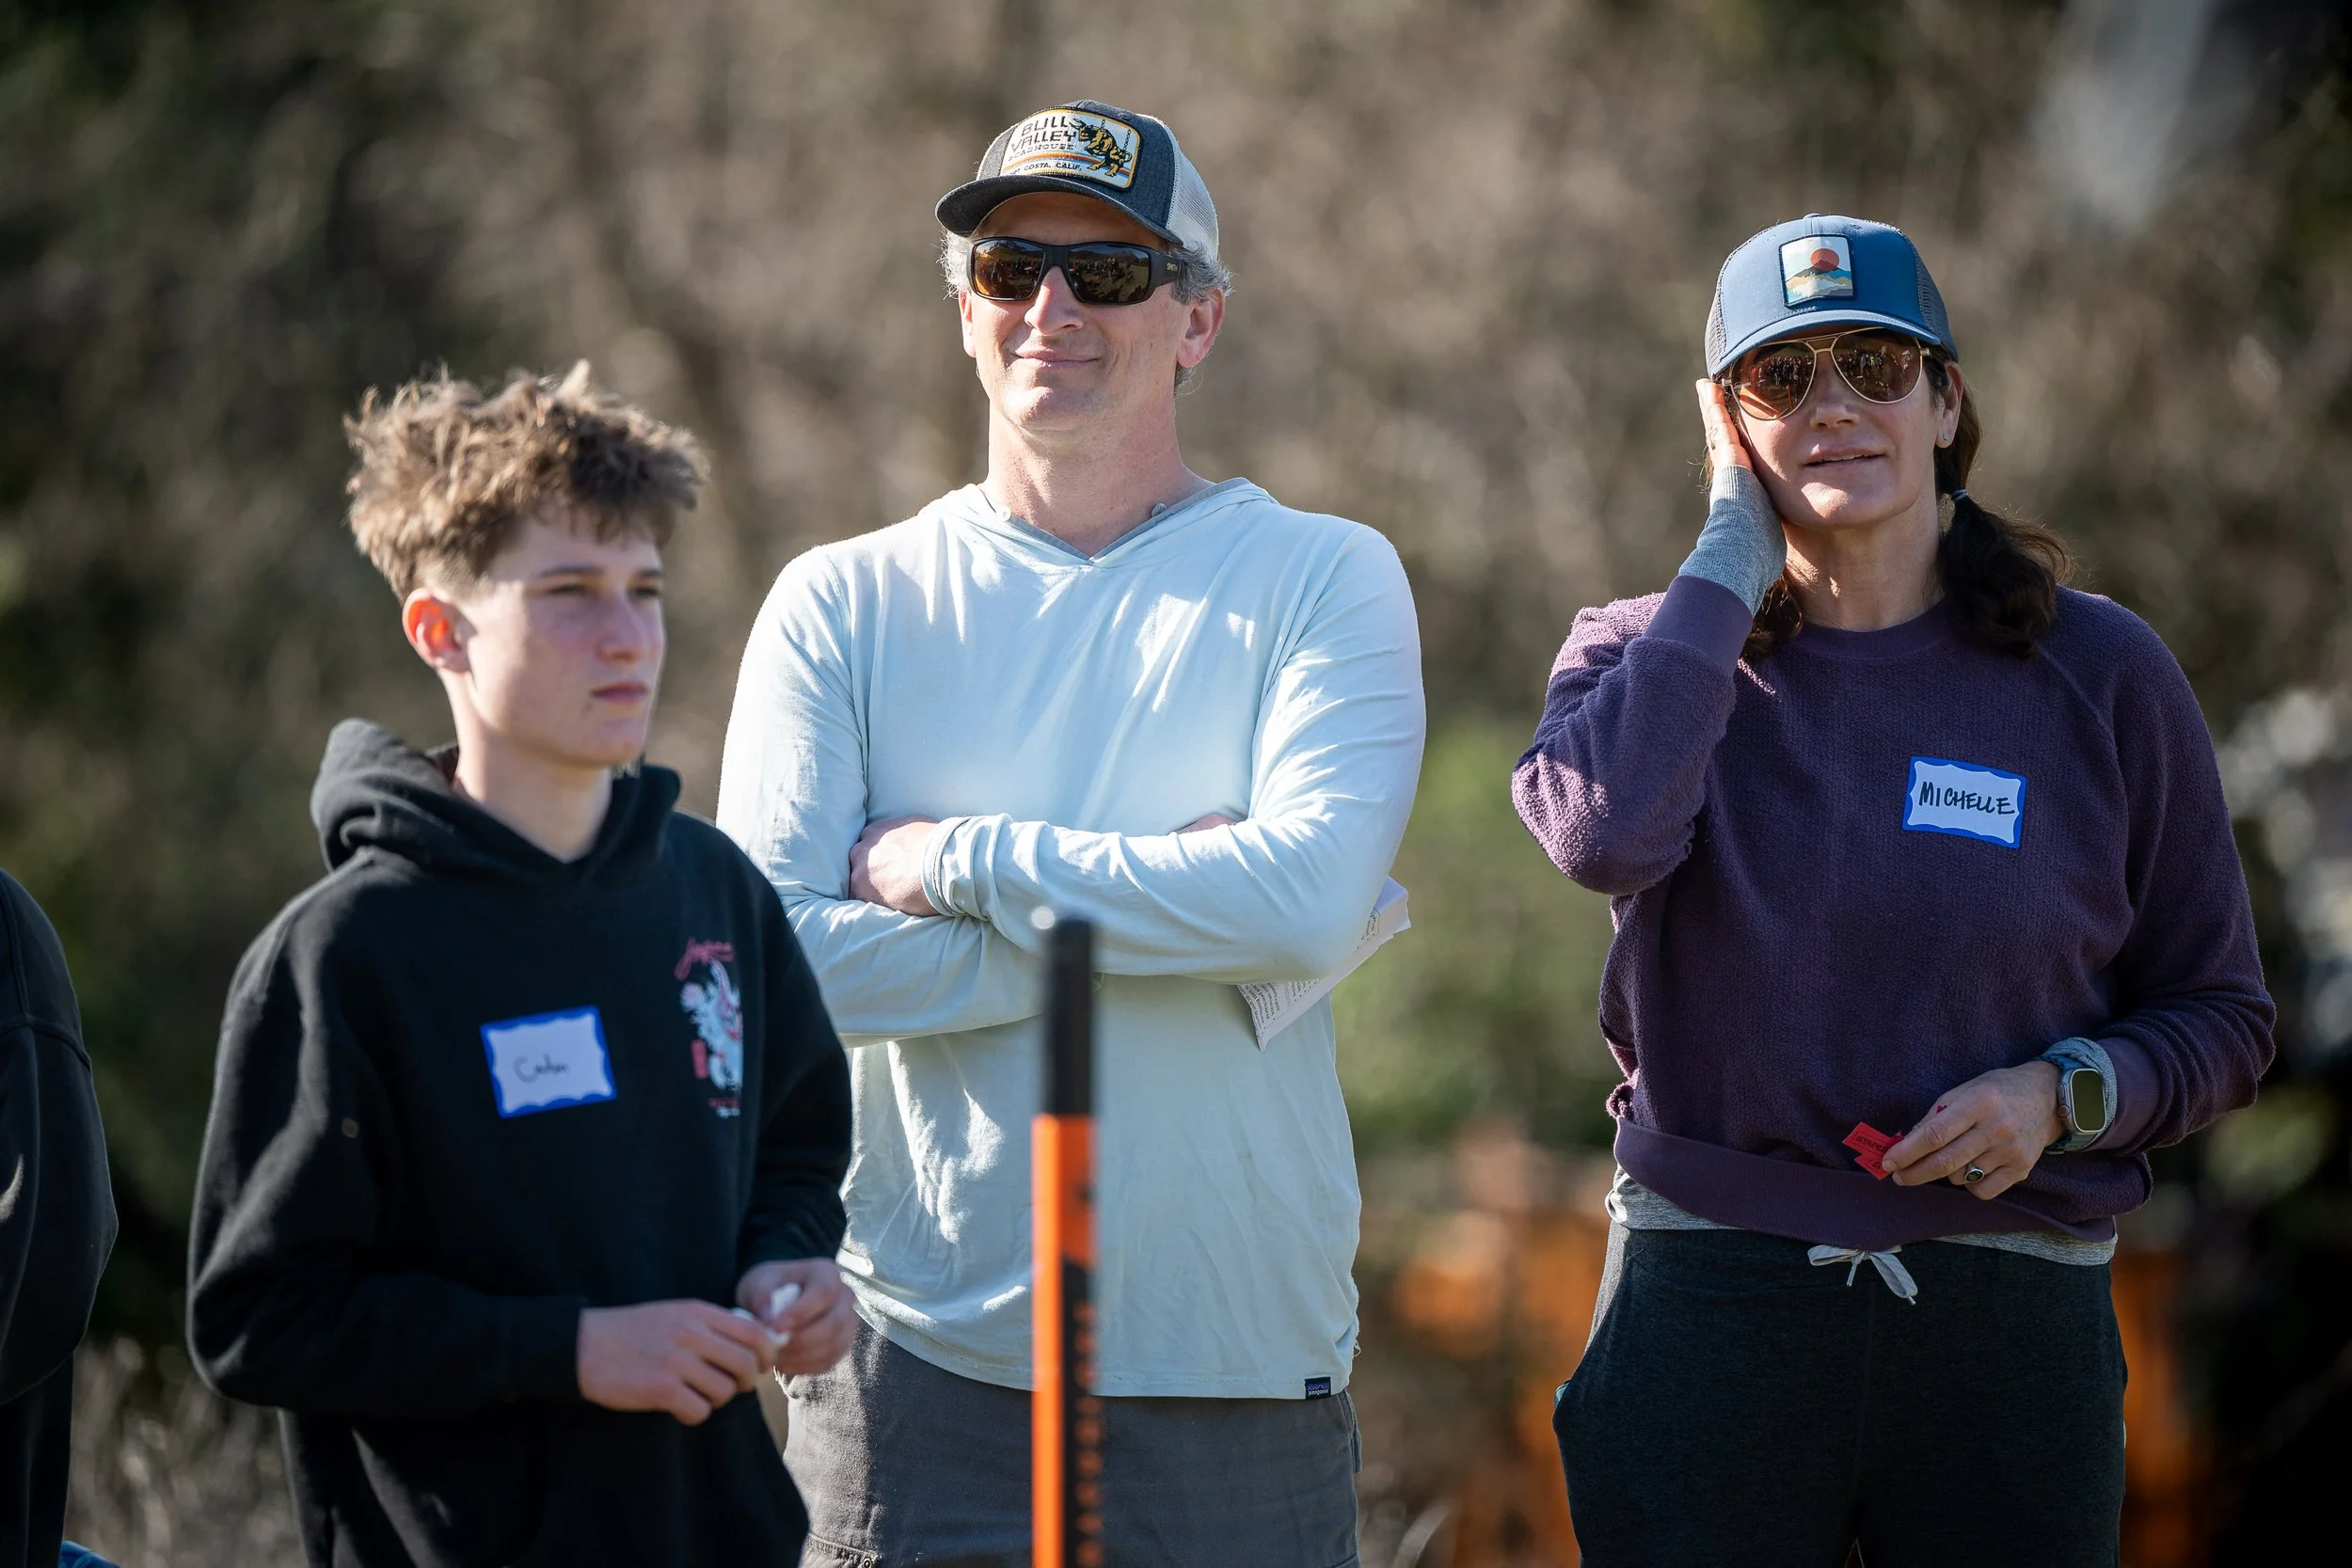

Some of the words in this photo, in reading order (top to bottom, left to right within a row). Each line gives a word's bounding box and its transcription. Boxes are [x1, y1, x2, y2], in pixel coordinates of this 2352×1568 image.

[1022, 116, 1068, 136] BULL
[1011, 131, 1076, 152] VALLEY
[1918, 781, 2015, 816] MICHELLE
